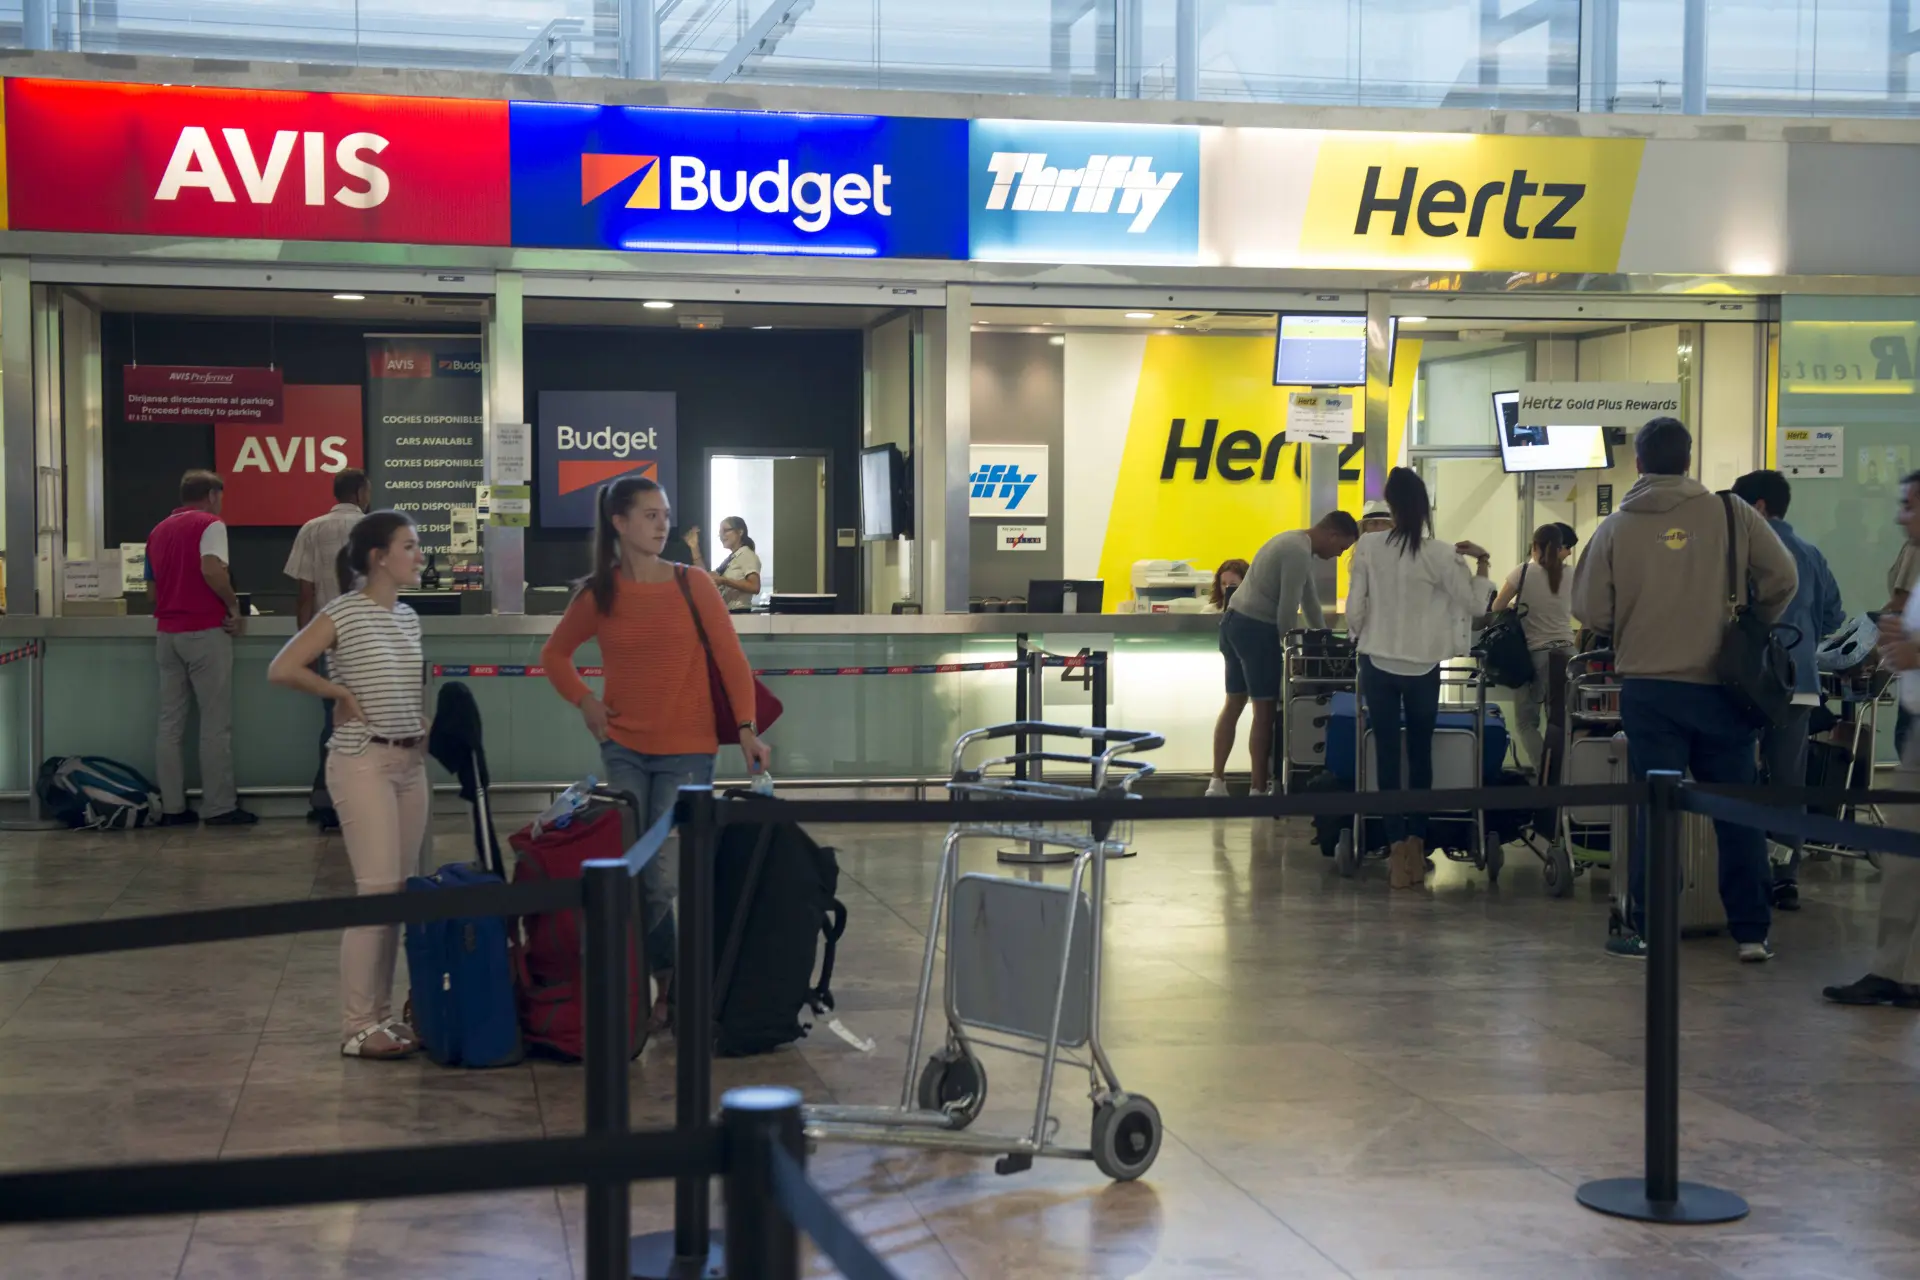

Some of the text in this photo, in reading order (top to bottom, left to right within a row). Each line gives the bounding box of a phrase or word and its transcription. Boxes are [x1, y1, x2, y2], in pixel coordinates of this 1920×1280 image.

[154, 126, 390, 208] AVIS
[670, 155, 892, 232] Budget
[985, 152, 1183, 233] Thrifty
[1354, 166, 1586, 240] Hertz
[387, 360, 483, 373] AVIS Budg
[169, 372, 234, 384] AVIS Preferred
[128, 395, 274, 407] Dirijanse directamente al parking
[1297, 396, 1318, 406] Hertz
[1522, 396, 1677, 411] Hertz Gold Plus Rewards
[142, 406, 262, 418] Proceed directly to parking
[382, 415, 484, 424] COCHES DISPONIBLES
[396, 437, 474, 446] CARS AVAILABLE
[557, 425, 658, 458] Budget
[1787, 431, 1808, 440] Hertz
[231, 436, 348, 474] AVIS
[1160, 418, 1365, 481] Herz
[384, 459, 484, 467] COTXES DISPONIBLES
[384, 480, 424, 489] CARROS
[393, 503, 420, 511] AUTO
[1061, 647, 1094, 691] 4
